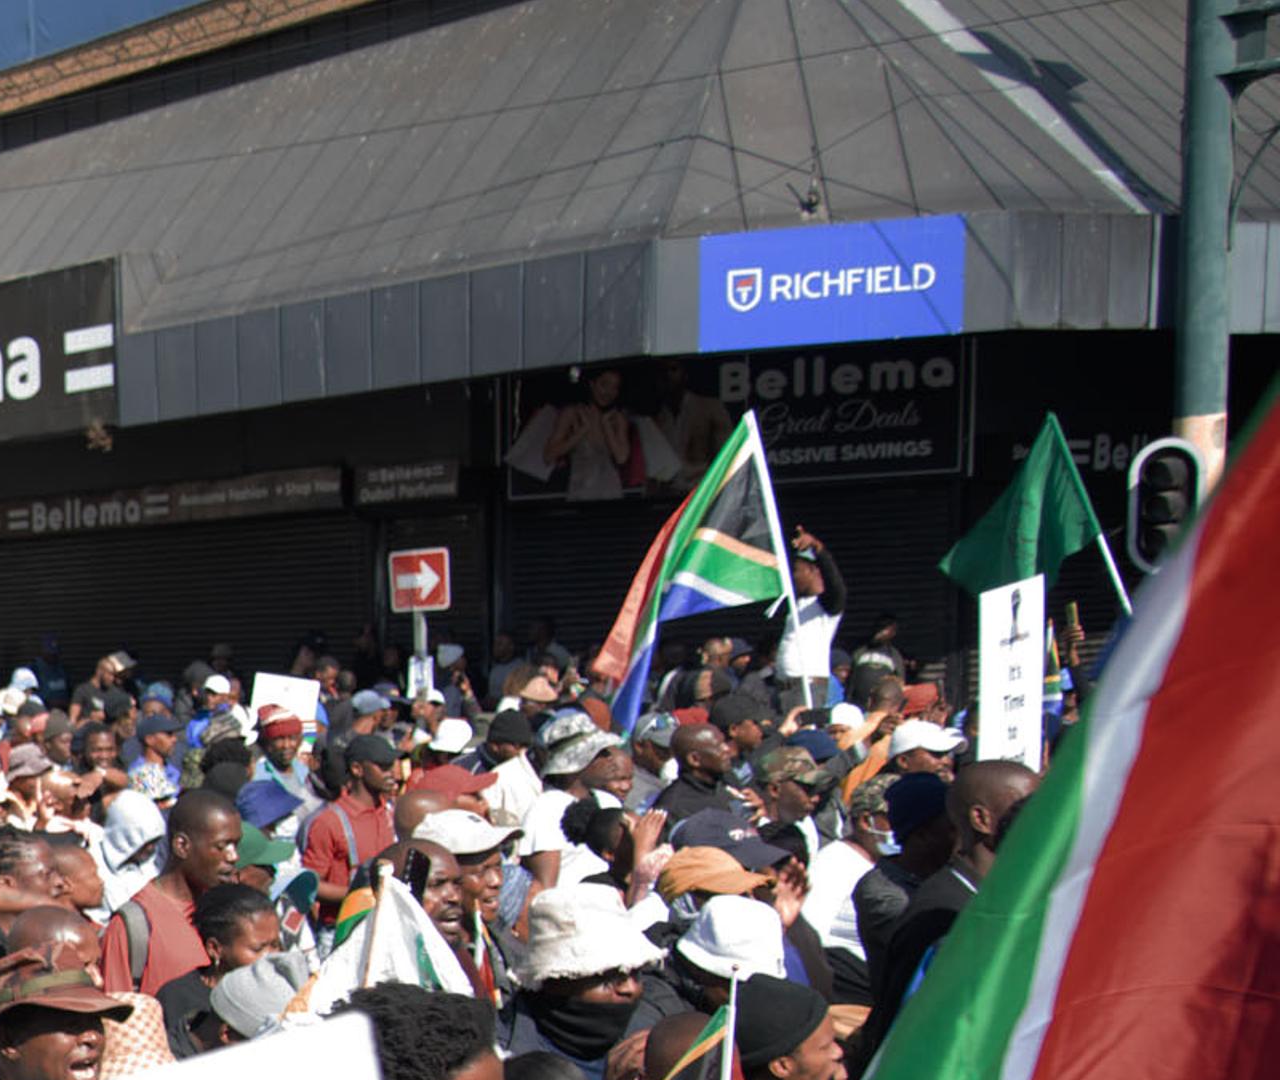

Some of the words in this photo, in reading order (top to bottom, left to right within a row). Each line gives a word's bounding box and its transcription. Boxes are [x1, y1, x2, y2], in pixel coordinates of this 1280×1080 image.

[769, 262, 936, 302] RICHFIELD
[719, 355, 956, 404] Bellema
[760, 402, 833, 446] Great
[835, 399, 923, 433] Deals
[766, 445, 837, 466] ASSIVE
[840, 440, 934, 460] SAVINGS
[31, 497, 141, 533] Bellema
